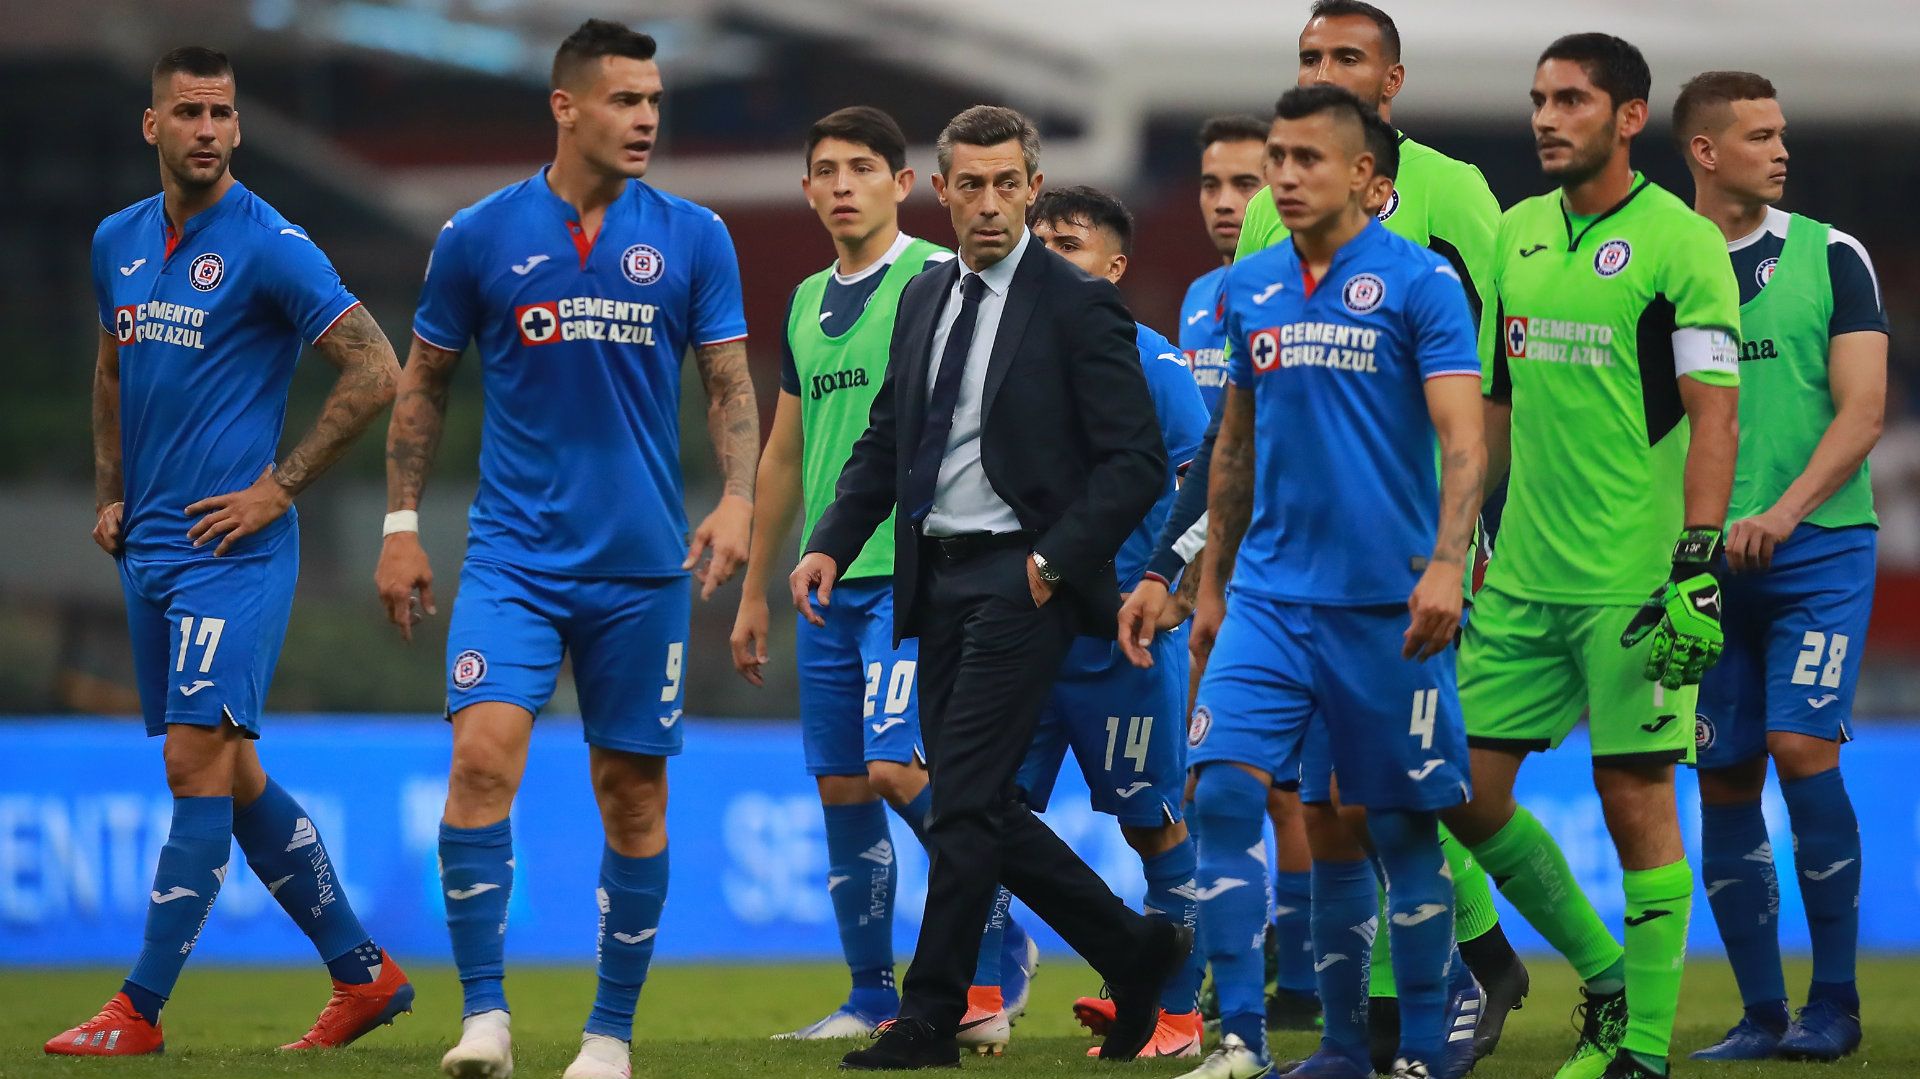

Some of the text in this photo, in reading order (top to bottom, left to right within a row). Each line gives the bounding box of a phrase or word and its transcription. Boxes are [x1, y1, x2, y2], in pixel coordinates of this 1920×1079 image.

[558, 297, 655, 324] CEMENTO
[136, 321, 205, 350] CUZ AZUL
[560, 319, 656, 346] CRUZ AZUL
[1281, 321, 1377, 350] CEMENTO
[1529, 317, 1612, 345] CEMENTO
[1326, 347, 1378, 373] AZUL
[1527, 340, 1616, 368] CRUZ AZUL
[176, 616, 226, 673] 17
[660, 642, 683, 702] 9
[1791, 630, 1849, 689] 28
[863, 660, 917, 718] 20
[1409, 688, 1438, 750] 4
[1104, 716, 1153, 773] 14
